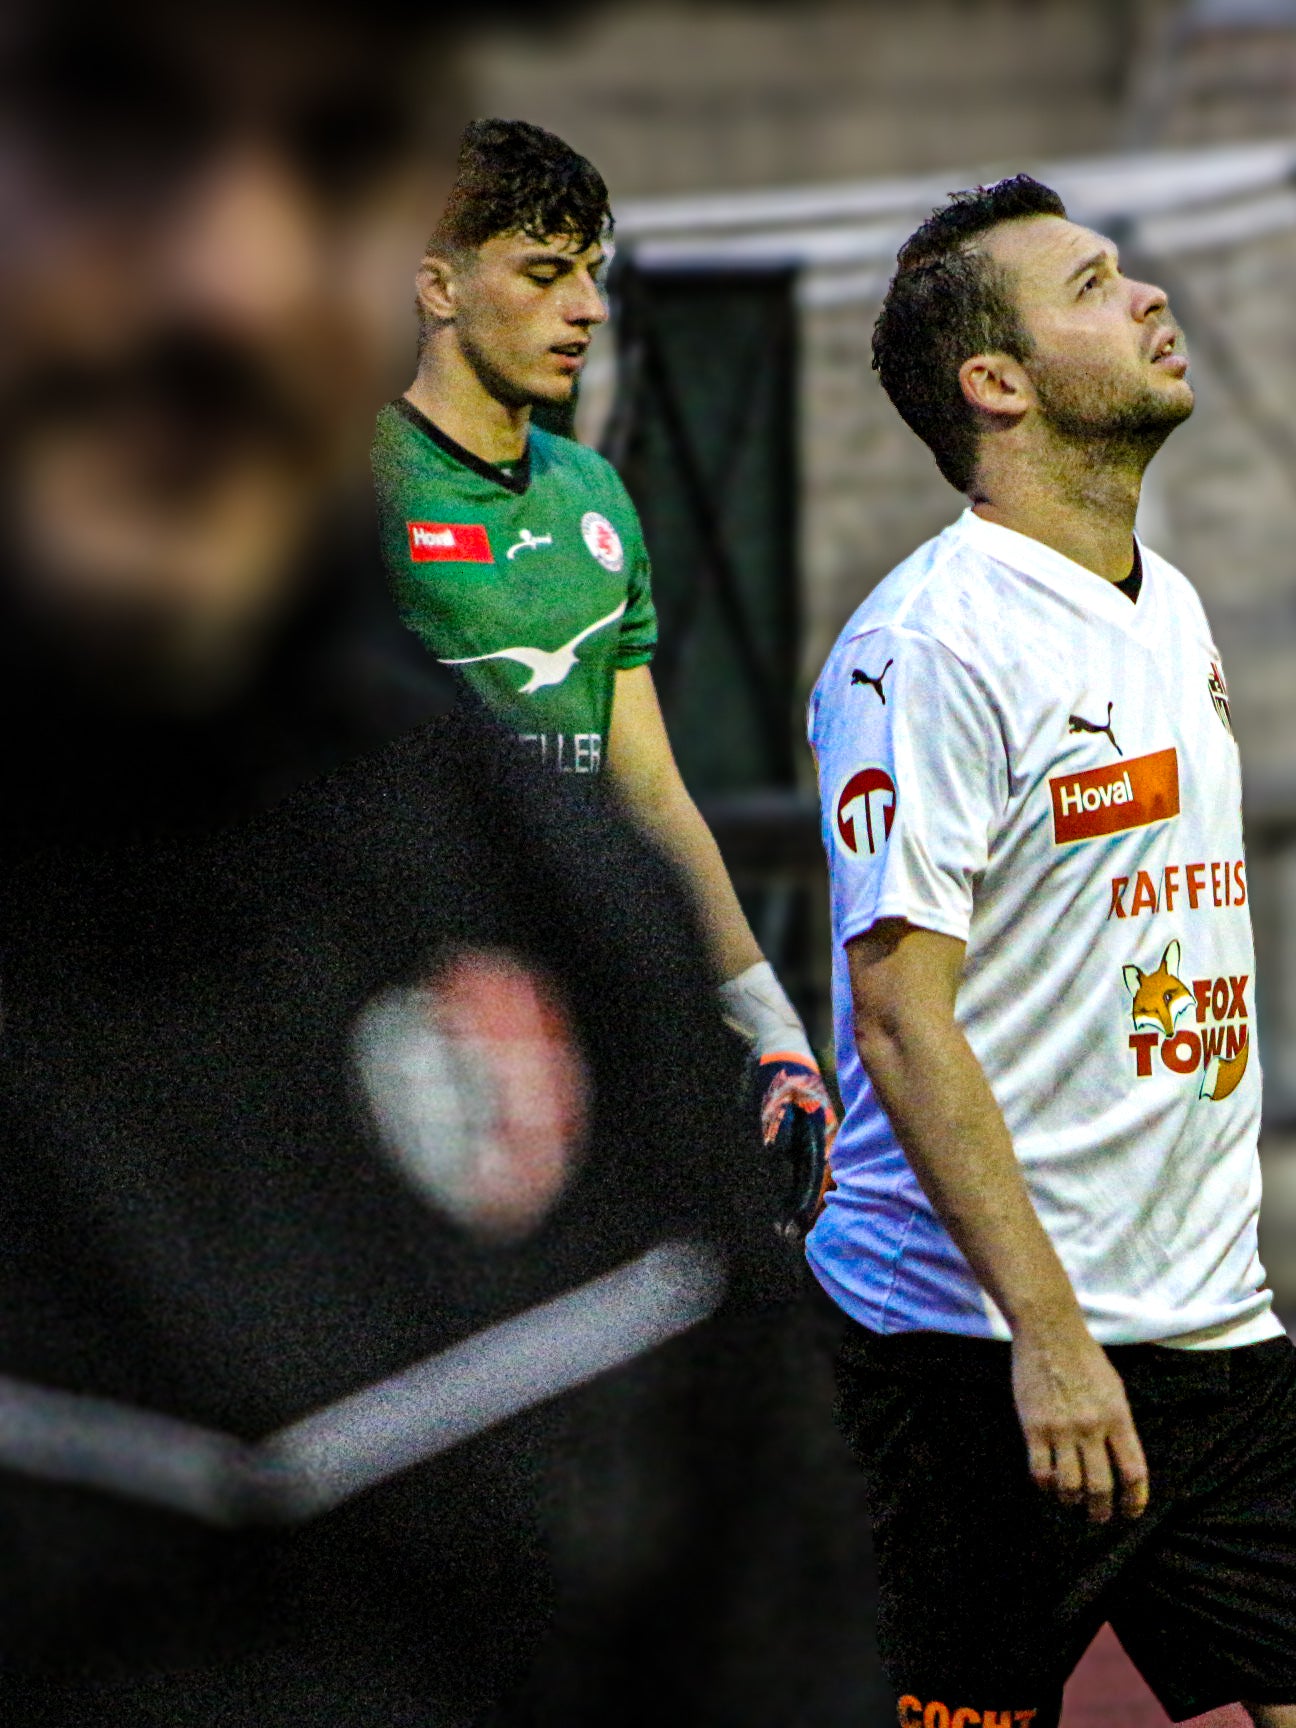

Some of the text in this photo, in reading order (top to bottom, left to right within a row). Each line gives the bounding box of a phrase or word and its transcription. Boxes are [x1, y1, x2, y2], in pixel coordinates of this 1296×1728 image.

[1059, 770, 1134, 817] Hoval
[1109, 860, 1247, 919] RAFFEIS
[1192, 974, 1249, 1024] FOX
[1128, 1023, 1249, 1078] TOWN
